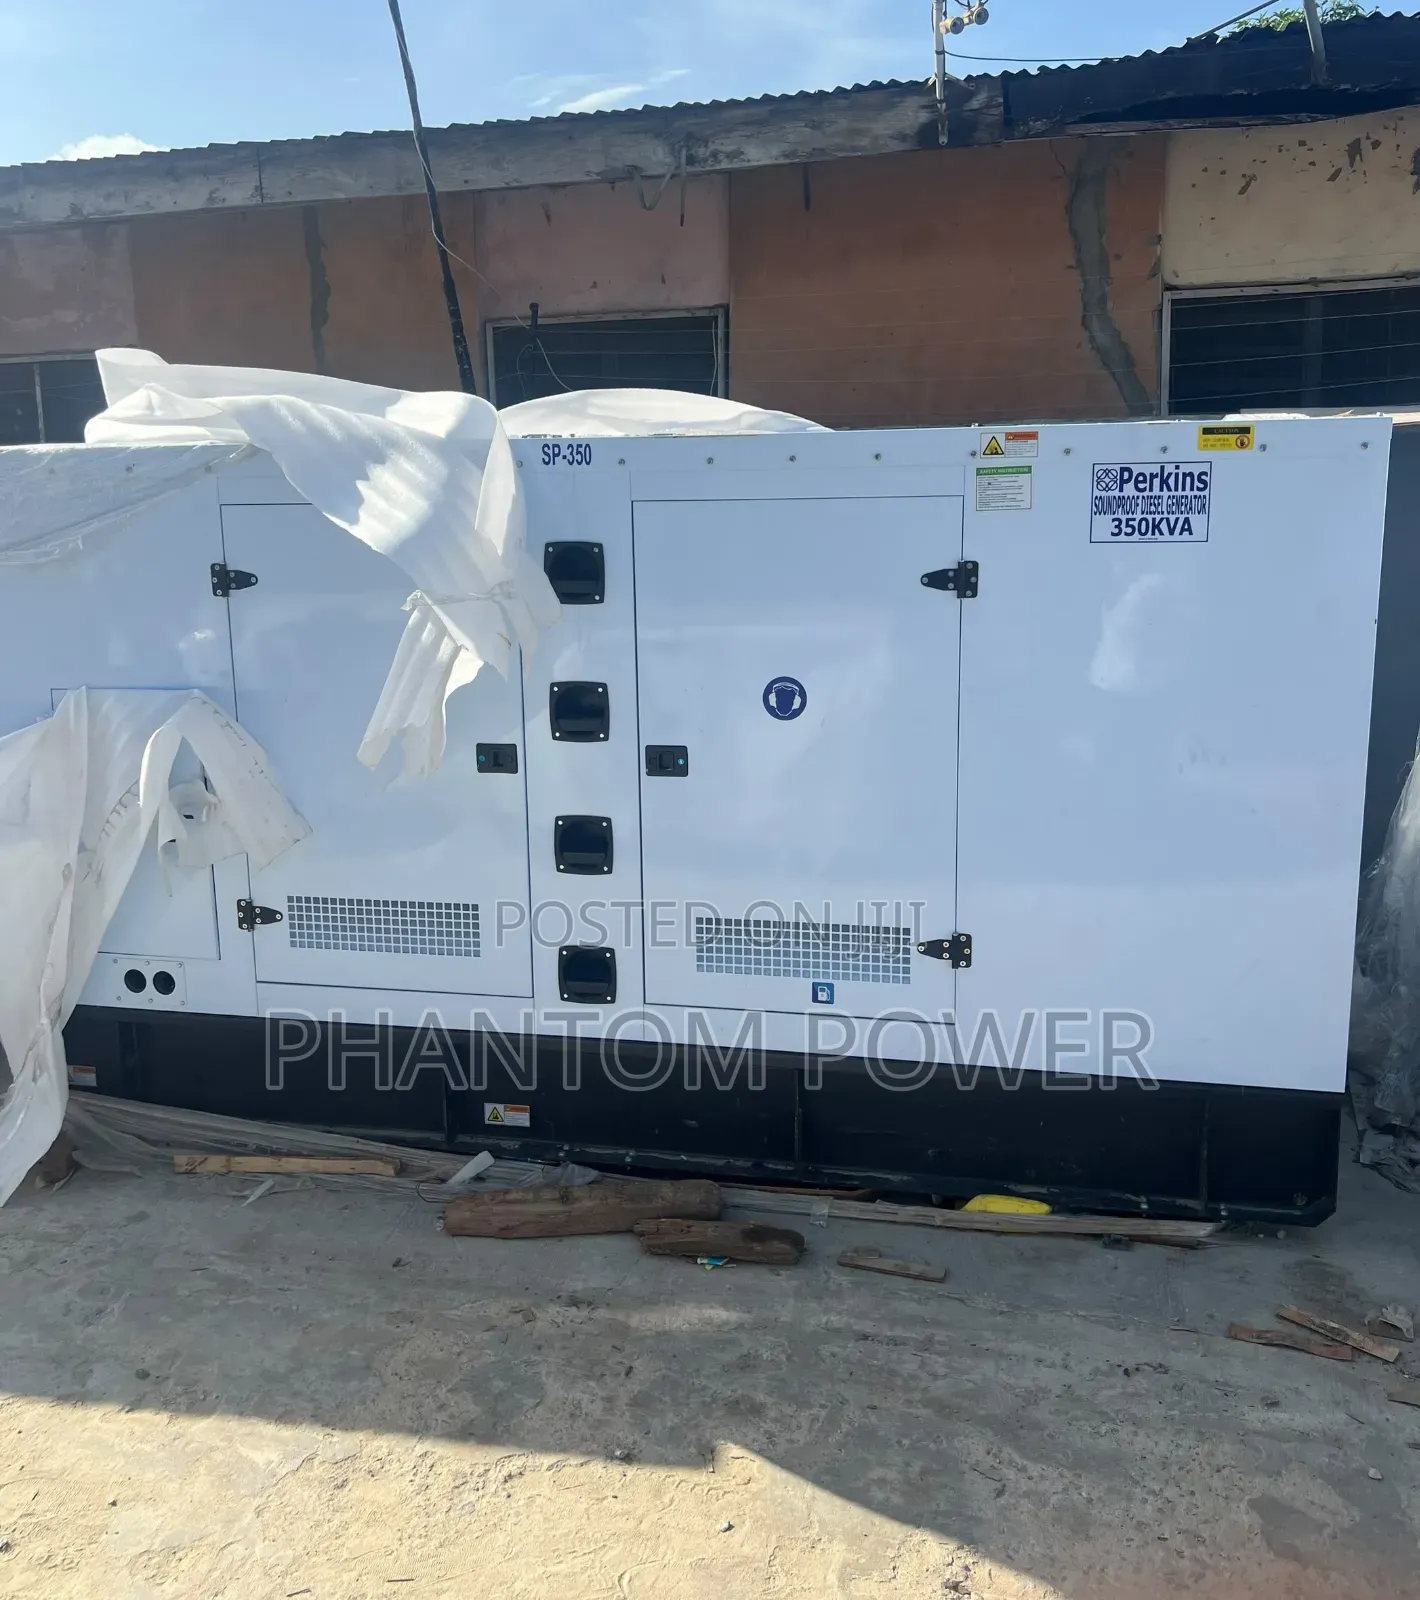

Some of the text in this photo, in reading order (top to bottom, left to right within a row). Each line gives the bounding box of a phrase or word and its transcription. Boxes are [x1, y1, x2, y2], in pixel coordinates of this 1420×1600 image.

[542, 443, 592, 466] SP-350
[1118, 465, 1209, 493] Perkins
[1094, 494, 1207, 516] SOUNDPROOF DIESEL GENERATOR
[1110, 517, 1194, 537] 350KVA
